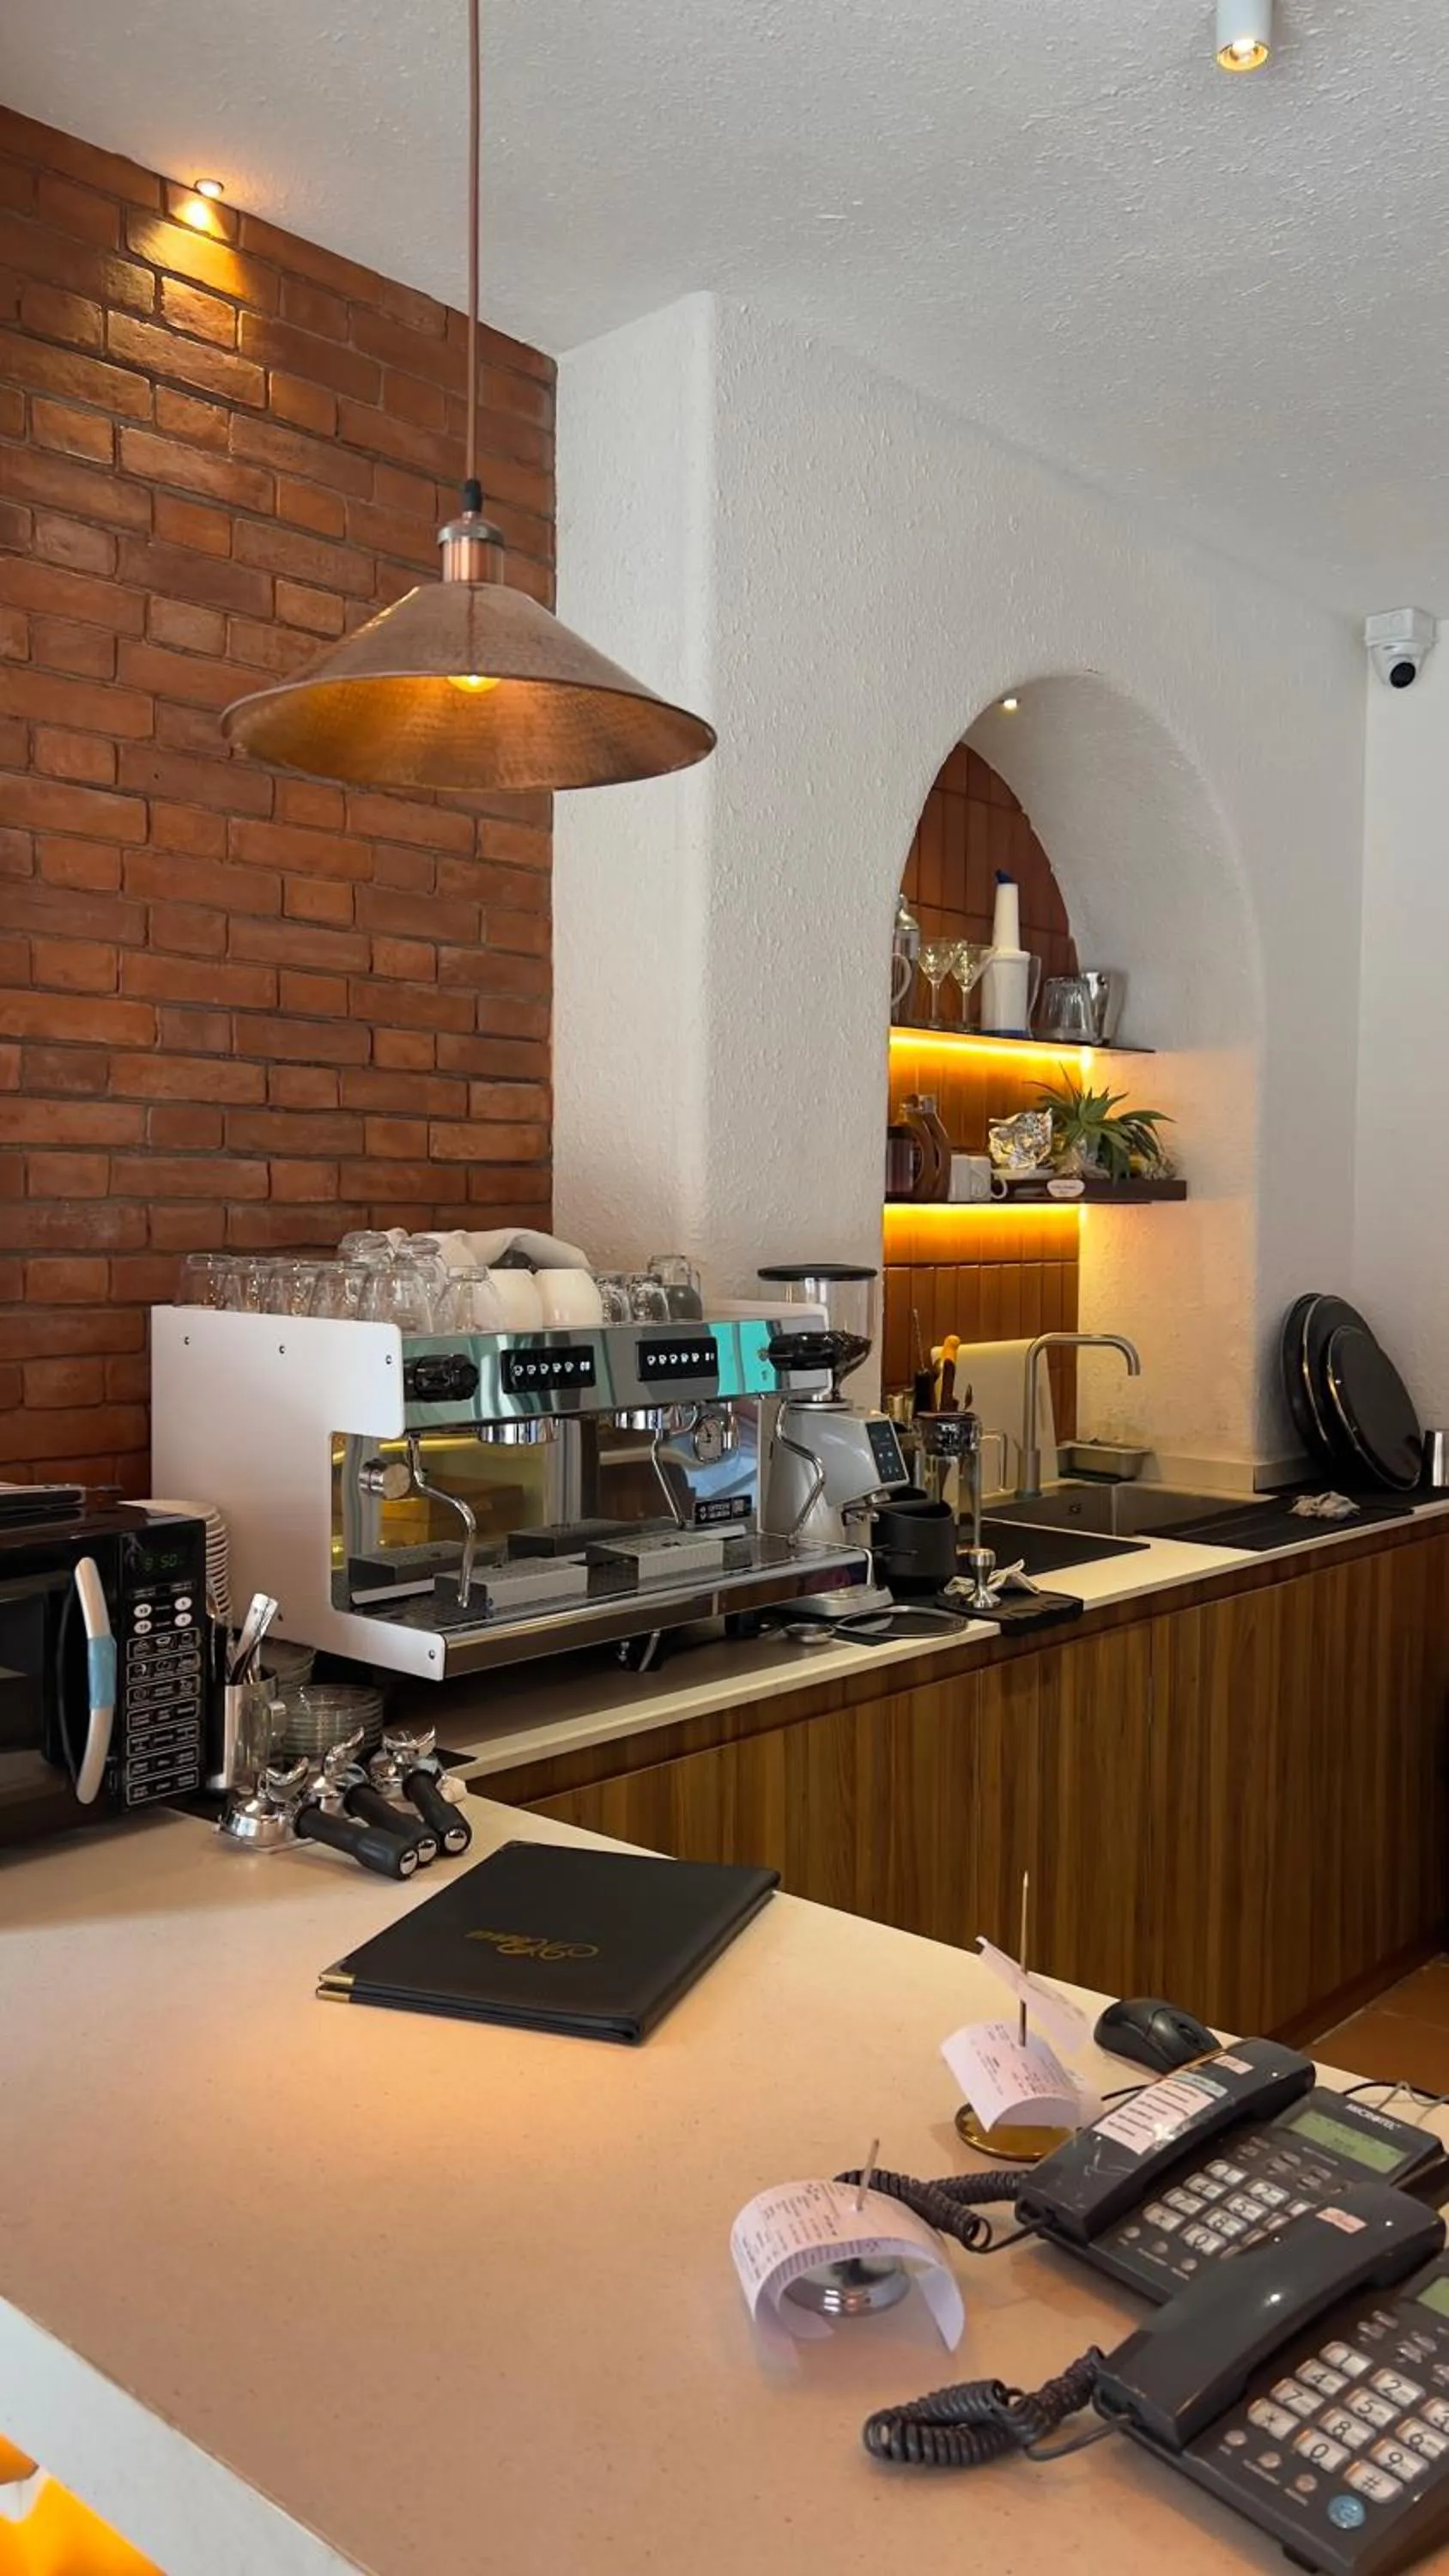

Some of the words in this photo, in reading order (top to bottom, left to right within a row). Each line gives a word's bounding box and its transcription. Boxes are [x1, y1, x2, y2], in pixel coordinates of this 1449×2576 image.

[1282, 2388, 1304, 2404] 7
[1381, 2378, 1403, 2397] 2
[1331, 2420, 1353, 2439] 8
[1310, 2442, 1331, 2460] 0
